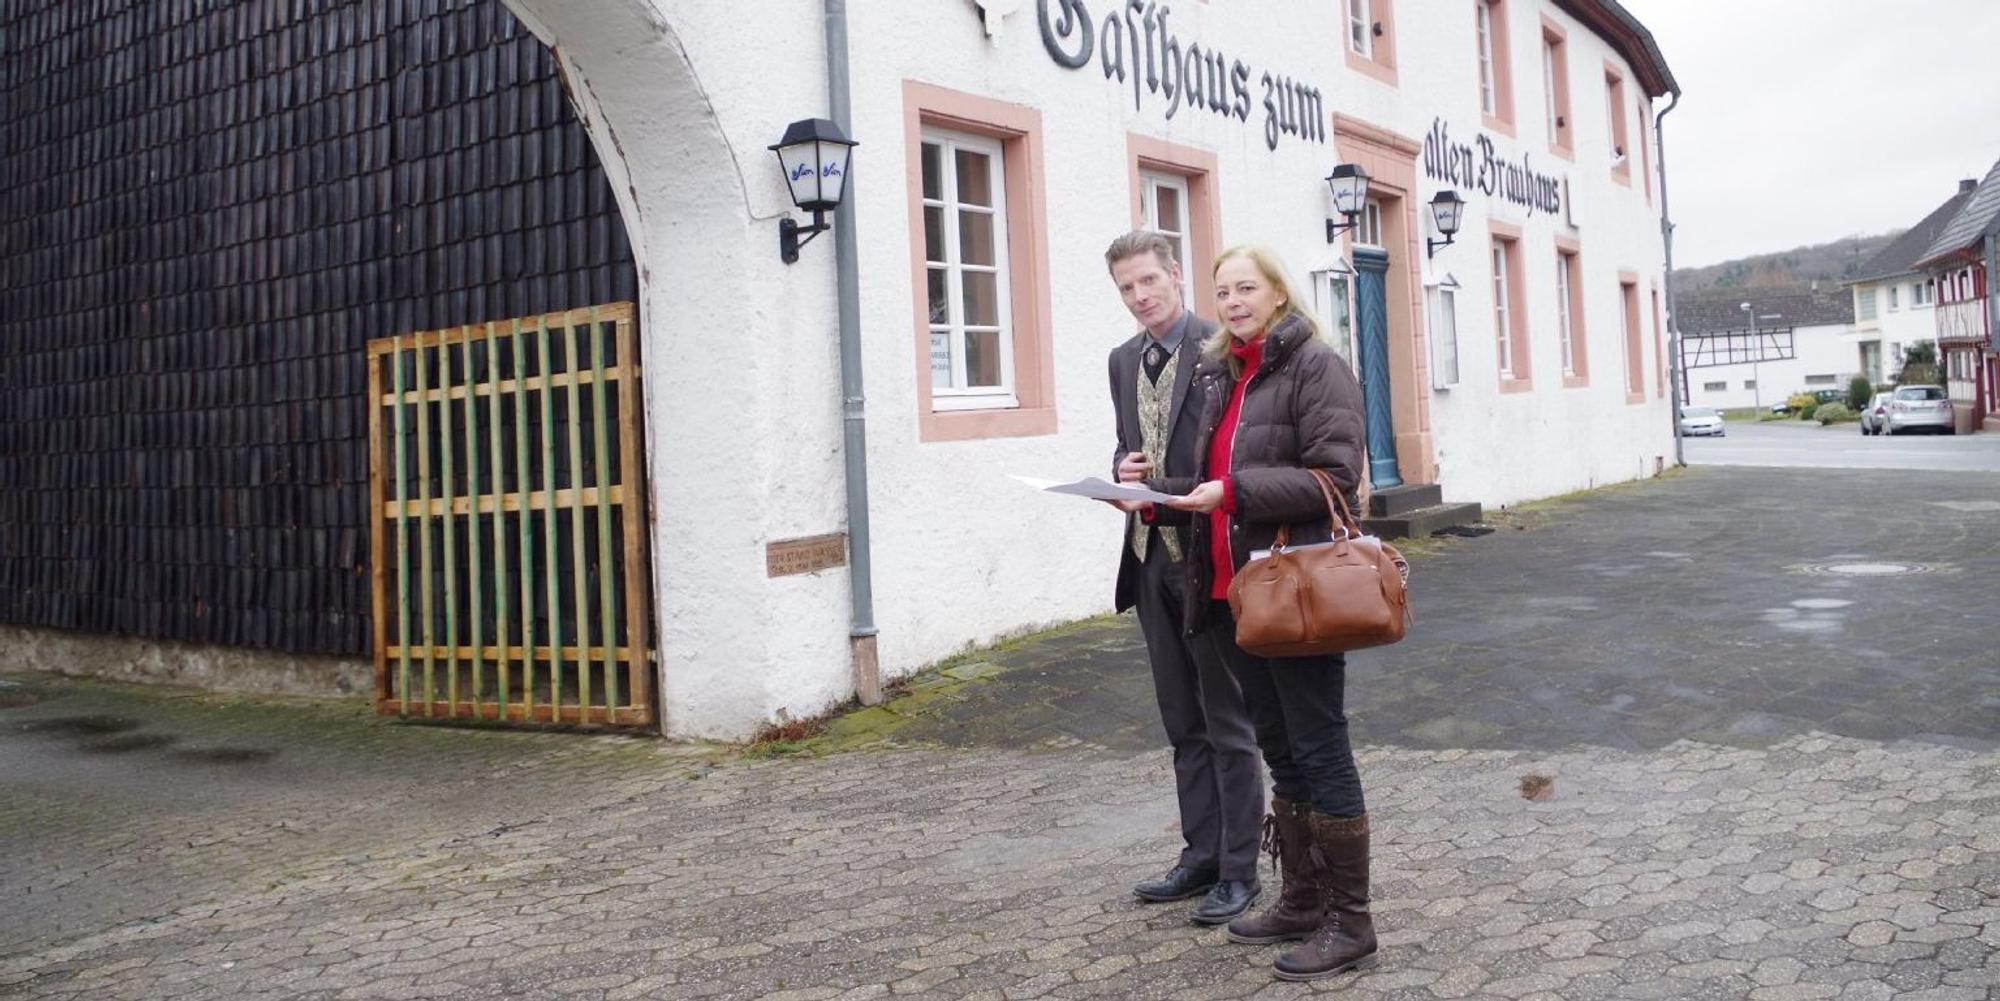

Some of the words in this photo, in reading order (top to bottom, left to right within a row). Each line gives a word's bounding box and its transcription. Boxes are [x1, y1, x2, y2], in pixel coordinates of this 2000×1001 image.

[1261, 70, 1326, 152] zum
[1424, 115, 1474, 190] alten
[1476, 133, 1560, 218] Brauhaus
